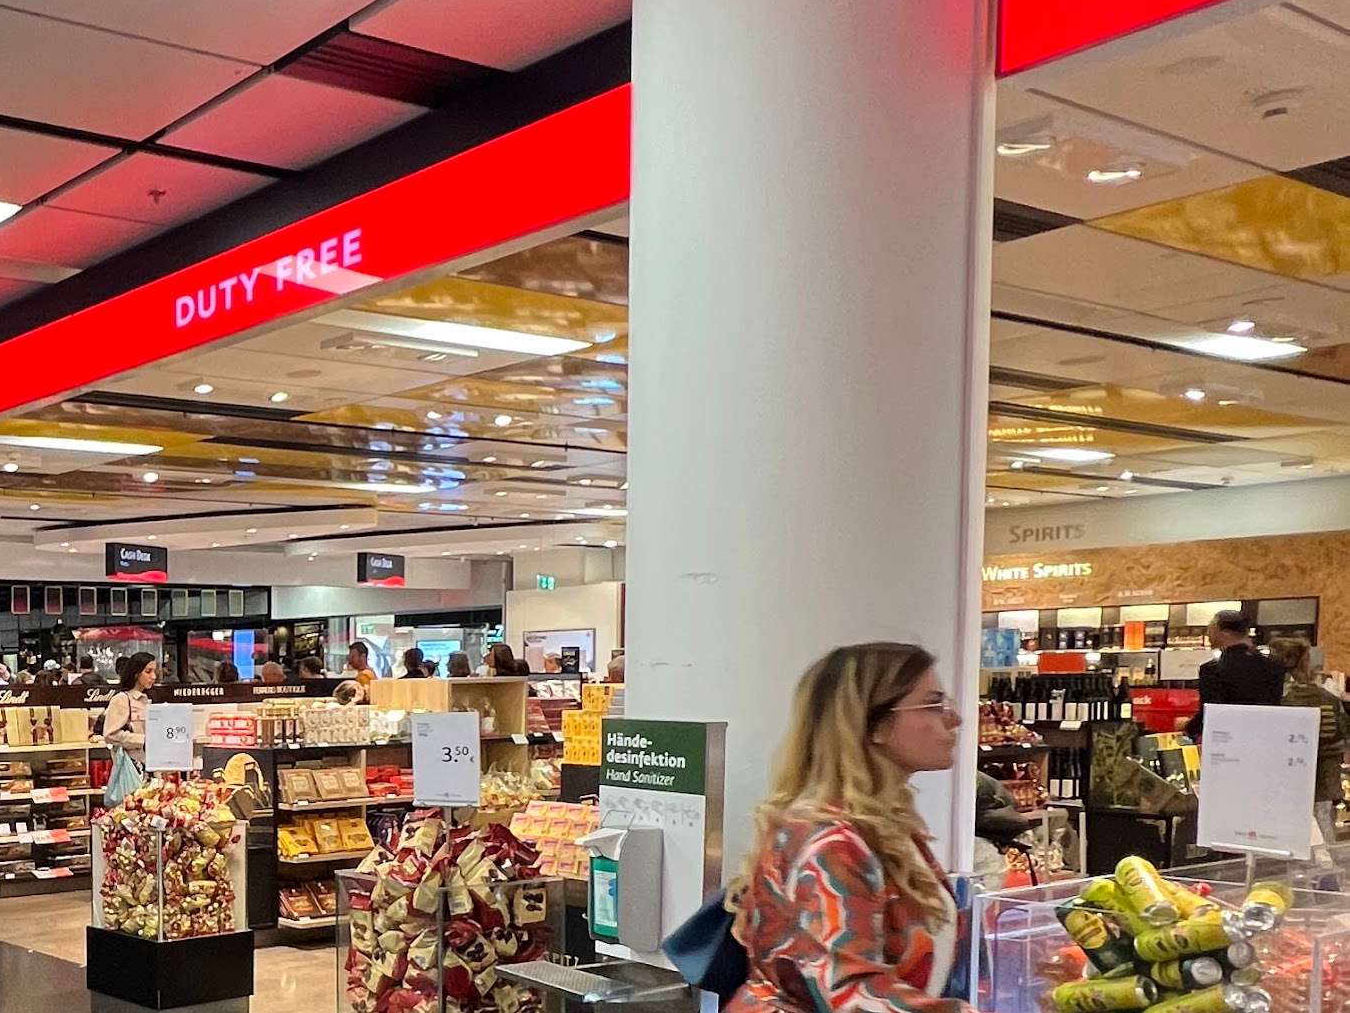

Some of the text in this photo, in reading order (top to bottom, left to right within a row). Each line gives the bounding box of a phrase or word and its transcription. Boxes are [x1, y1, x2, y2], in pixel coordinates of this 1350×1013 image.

[175, 227, 363, 328] DUTY FREE
[1009, 524, 1086, 544] SPIRITS
[982, 562, 1093, 581] WHITE SPIRITS
[607, 732, 653, 748] Hände-
[441, 746, 470, 763] 3.50
[606, 749, 686, 769] desinfektion
[605, 769, 675, 787] Hand Sanitizer
